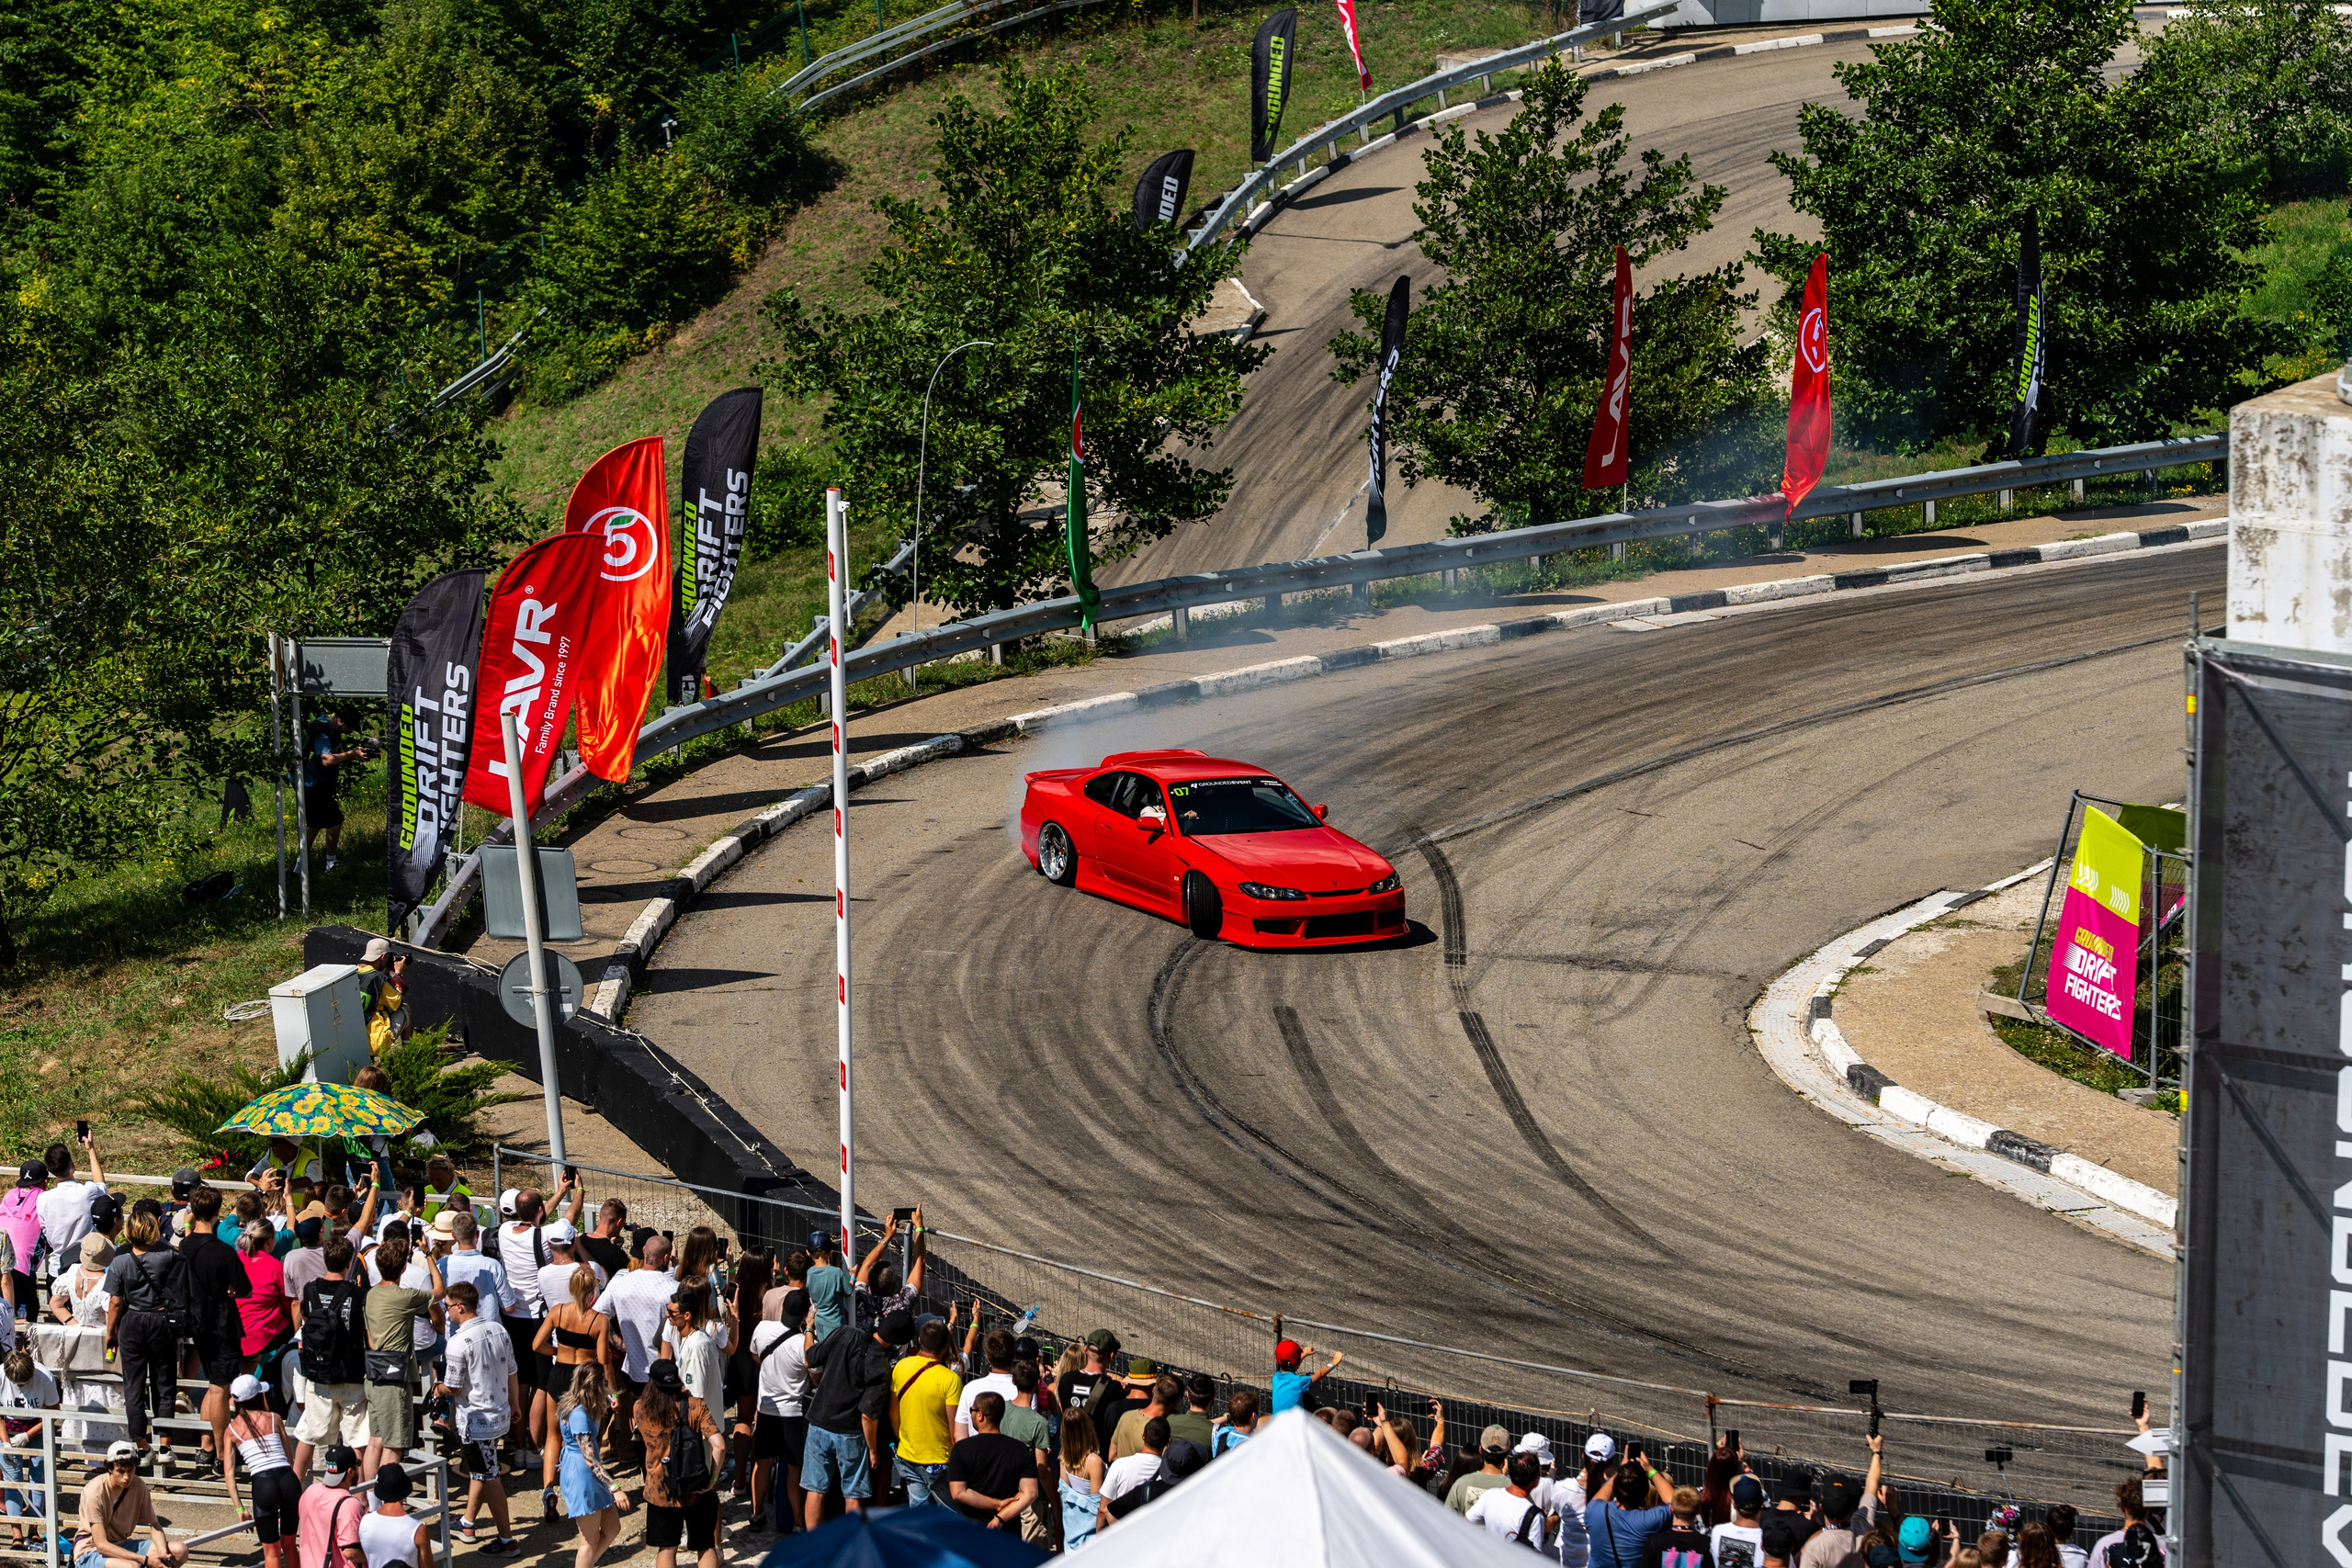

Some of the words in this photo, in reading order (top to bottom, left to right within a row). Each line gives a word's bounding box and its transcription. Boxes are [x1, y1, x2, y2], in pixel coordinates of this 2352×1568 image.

[2016, 294, 2039, 402] GROUNDED
[695, 487, 723, 611] DRIFT
[702, 468, 750, 629] FIGHTERS
[558, 636, 571, 659] 1997
[552, 661, 567, 688] since
[544, 688, 560, 720] Brand
[535, 721, 554, 754] Family
[399, 703, 418, 851] GROUNDED
[413, 685, 440, 850] DRIFT
[1172, 787, 1189, 796] 07
[2069, 944, 2118, 991] DRIFT
[2064, 972, 2122, 1021] FIGHTERS
